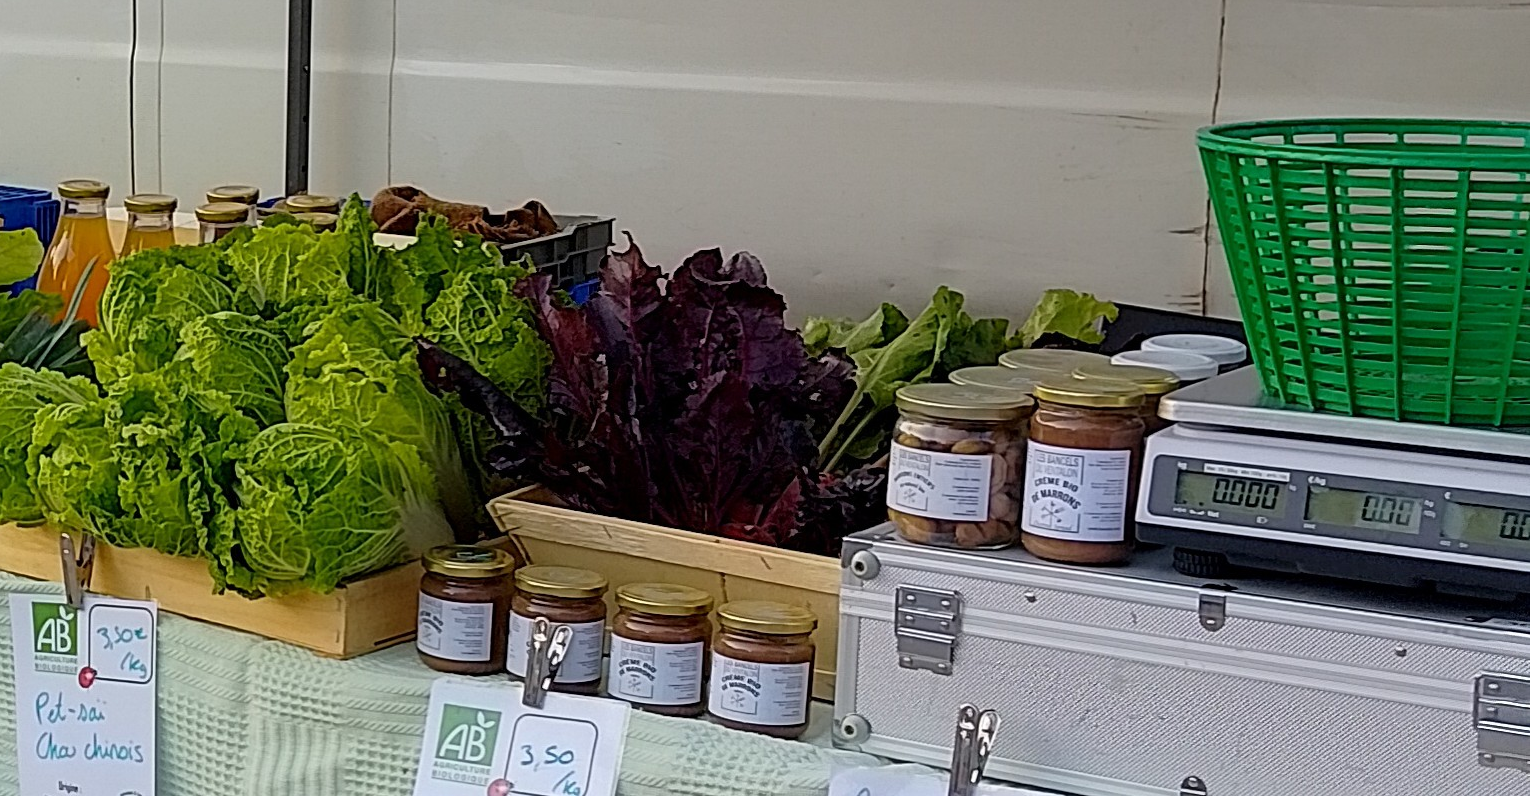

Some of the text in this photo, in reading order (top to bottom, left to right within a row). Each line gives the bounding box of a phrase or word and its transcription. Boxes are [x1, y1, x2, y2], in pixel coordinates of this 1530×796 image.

[1062, 480, 1079, 492] BIO
[1040, 489, 1081, 510] MARRONS
[36, 617, 73, 653] AB
[84, 732, 145, 764] chinois
[438, 722, 487, 763] AB
[432, 759, 491, 777] AGRICULTURE
[520, 744, 574, 772] 3,50
[431, 768, 490, 785] BIOLOGIQUE
